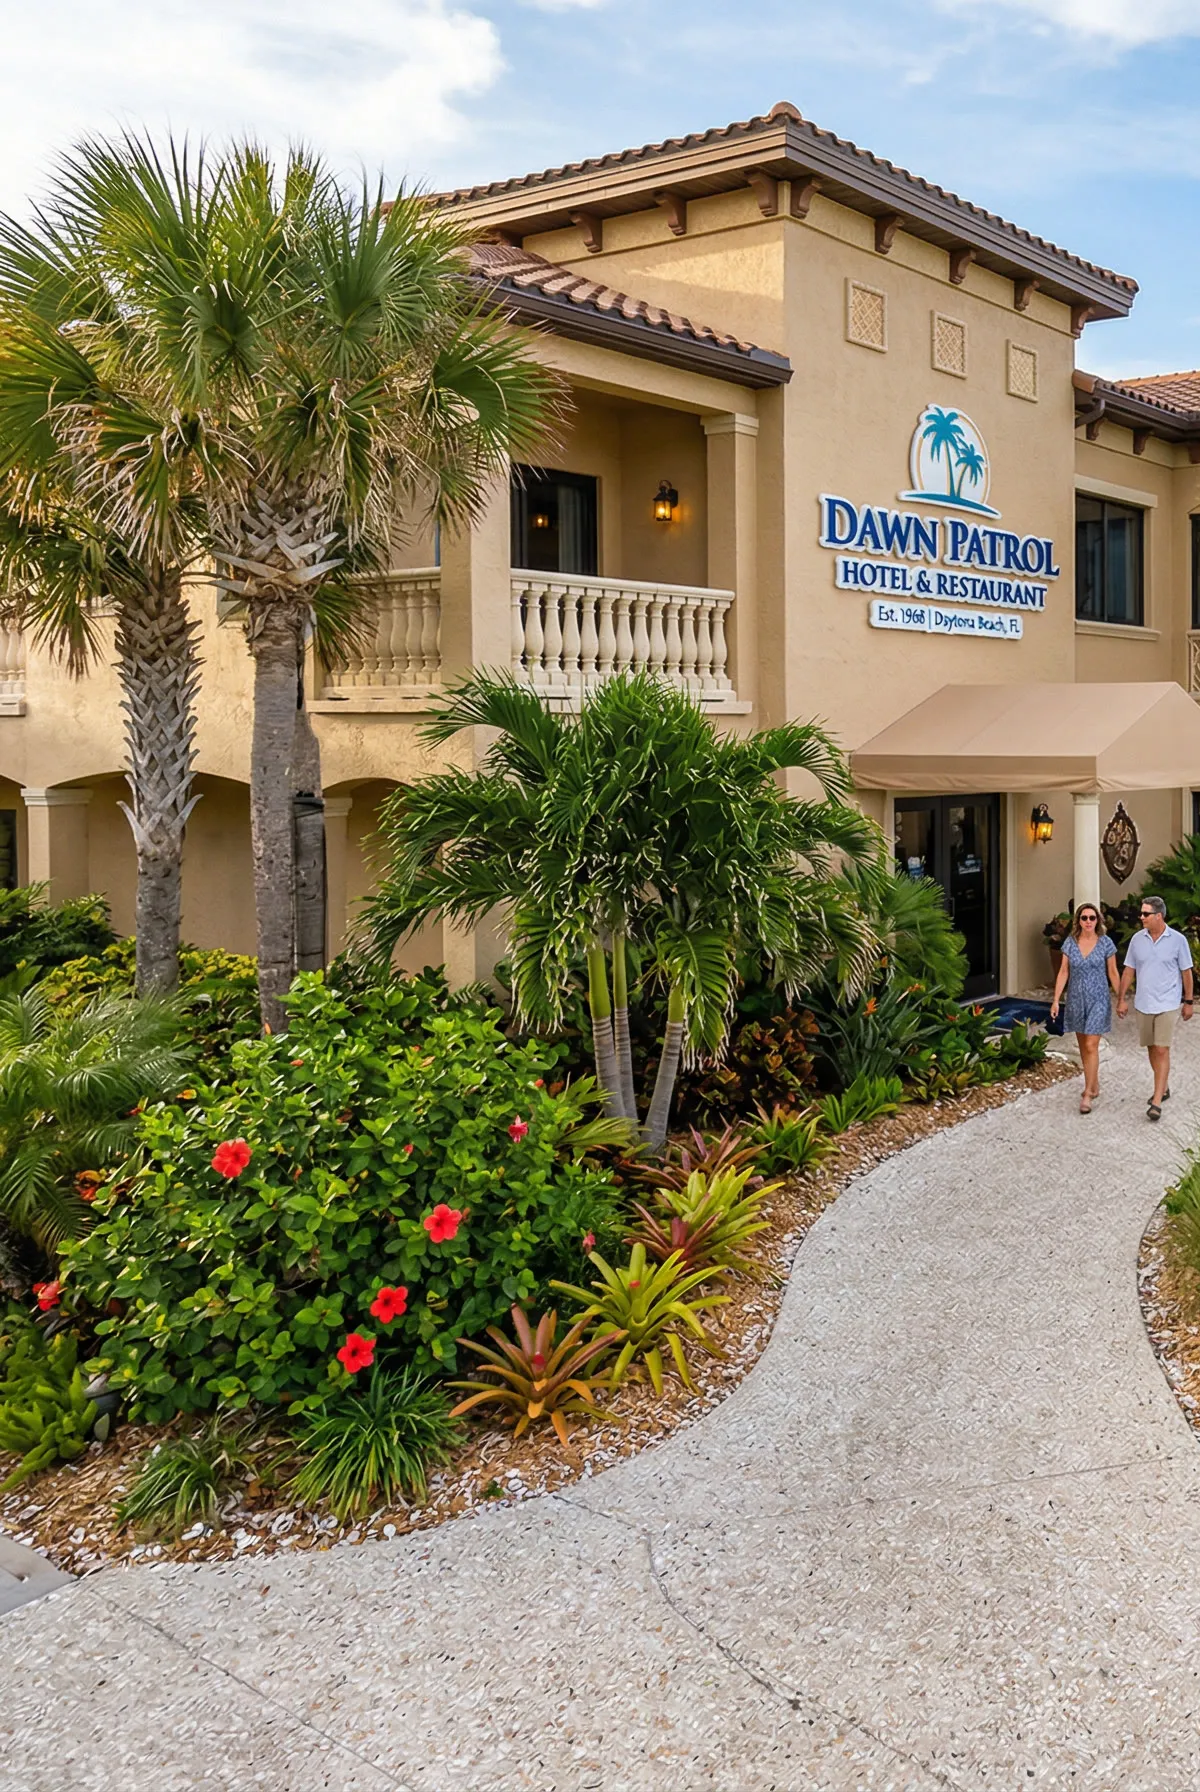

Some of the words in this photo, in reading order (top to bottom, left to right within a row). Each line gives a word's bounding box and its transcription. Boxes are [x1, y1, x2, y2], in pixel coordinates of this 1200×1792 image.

[825, 498, 939, 559] DAWN
[949, 520, 1060, 576] PATROL
[842, 560, 912, 591] HOTEL
[916, 569, 933, 593] &
[937, 573, 1048, 607] RESTAURANT
[878, 605, 898, 622] Est.
[1010, 619, 1020, 633] FL
